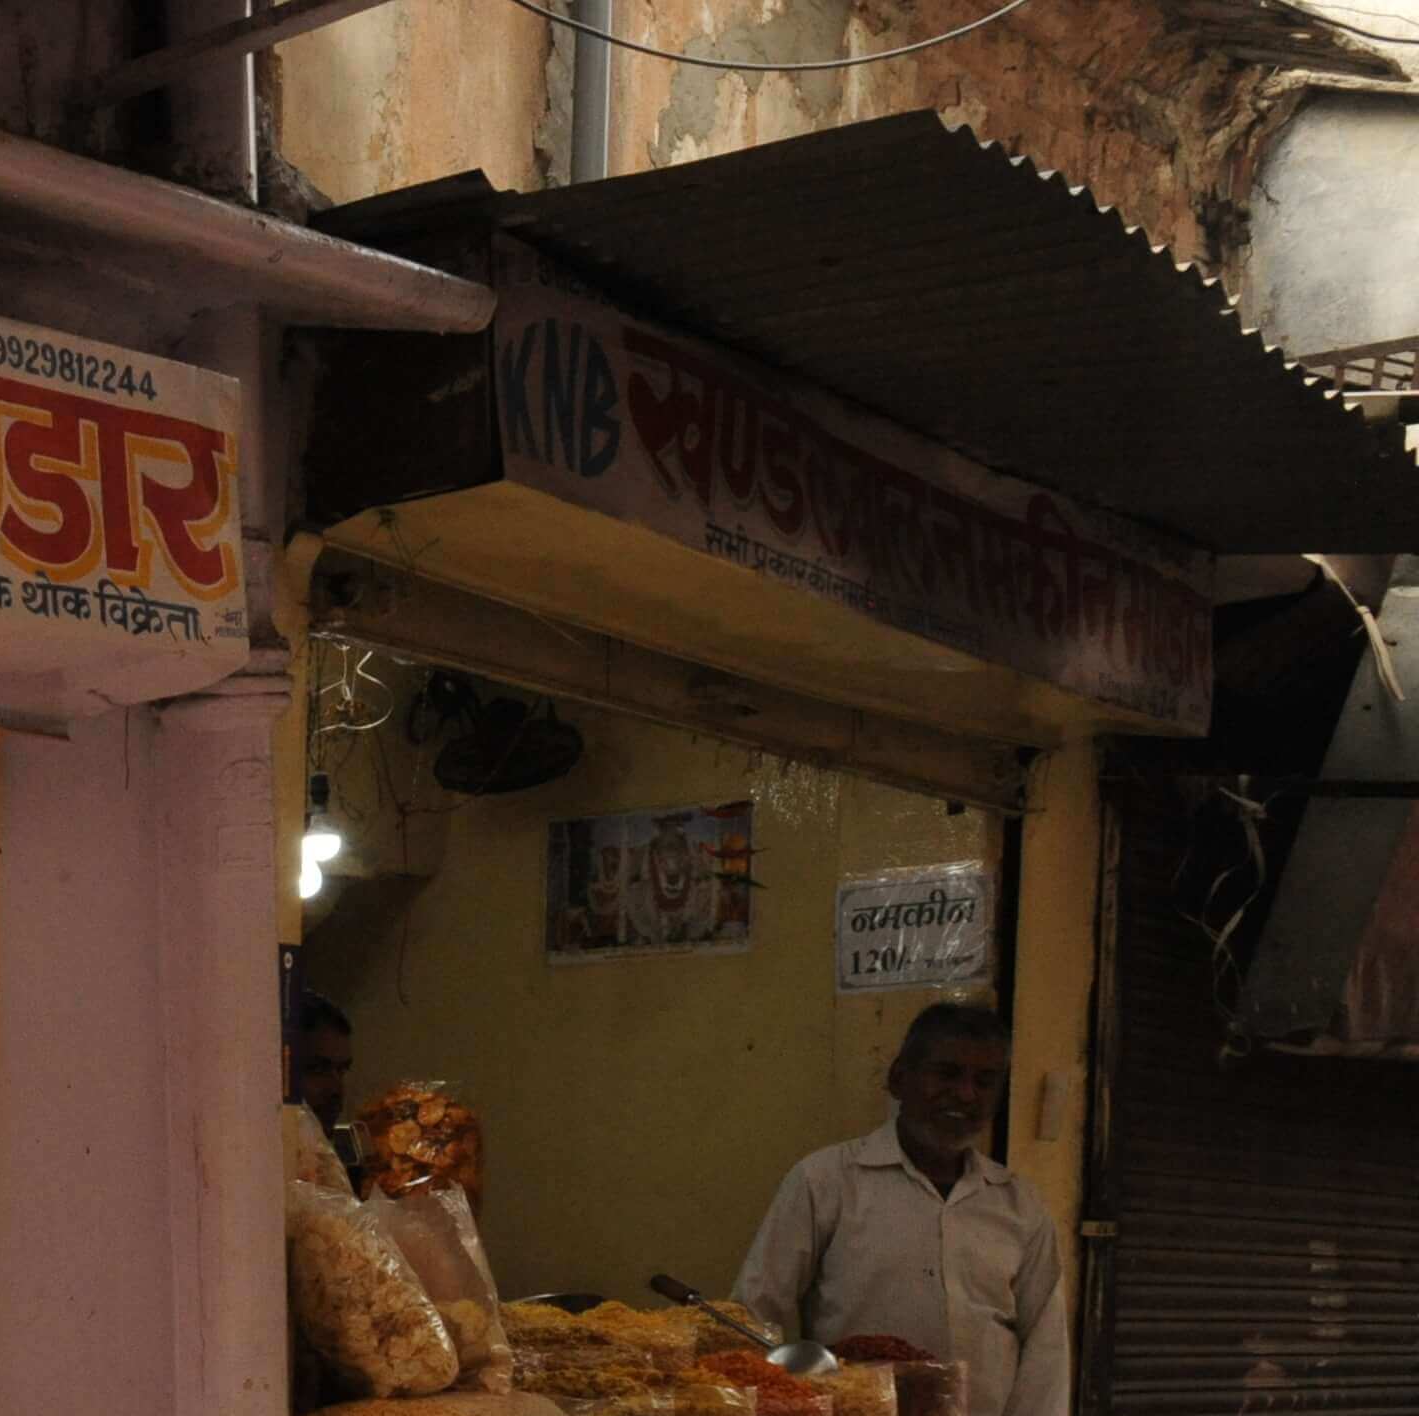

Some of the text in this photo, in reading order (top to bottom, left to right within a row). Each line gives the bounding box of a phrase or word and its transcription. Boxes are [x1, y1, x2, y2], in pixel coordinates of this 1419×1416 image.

[502, 317, 620, 478] KNB
[21, 570, 91, 620] थोक
[851, 889, 976, 932] नमकीन
